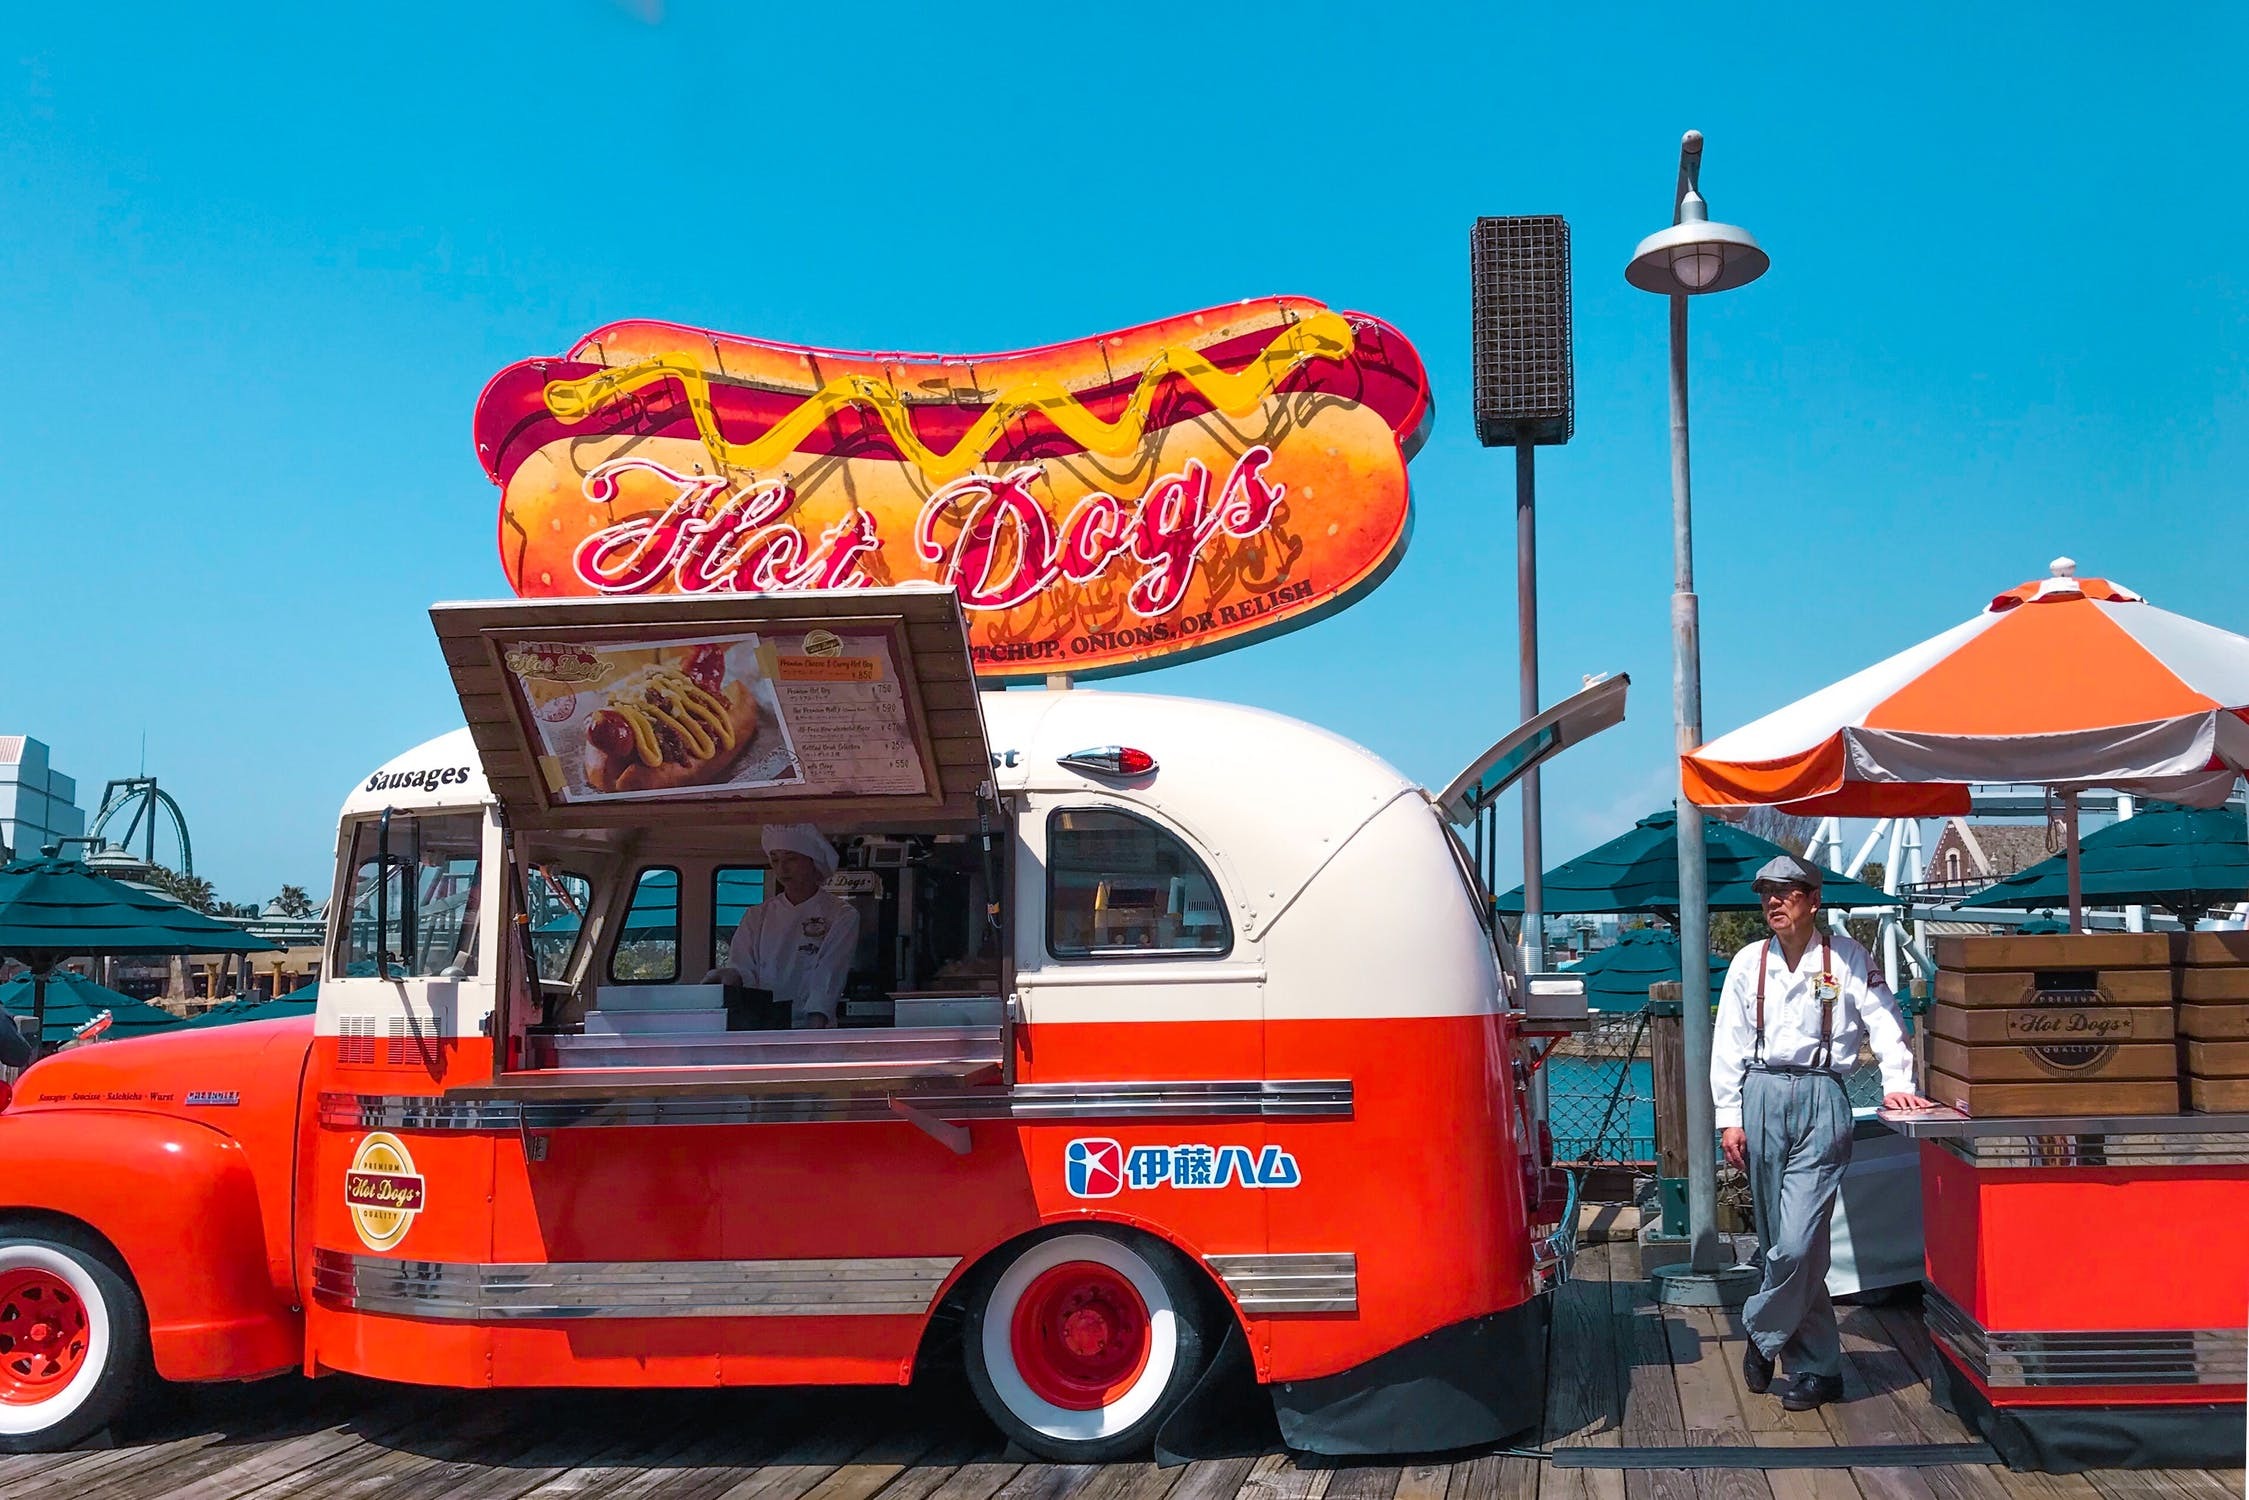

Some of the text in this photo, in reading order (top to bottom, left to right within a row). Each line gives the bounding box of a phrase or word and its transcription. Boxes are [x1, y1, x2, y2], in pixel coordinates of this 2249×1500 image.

[572, 445, 1286, 618] Hot Dogs
[967, 579, 1315, 663] TCHUP, ONIONS, OR RELISH
[365, 766, 470, 792] Sausages
[2039, 995, 2097, 1003] PREMIUM
[2020, 1012, 2119, 1037] Hot Dogs
[2043, 1045, 2098, 1054] QUALITY
[363, 1161, 400, 1171] PREMIUM
[1127, 1147, 1299, 1186] 伊藤ハム
[352, 1176, 415, 1208] Hot Dogs
[363, 1210, 398, 1220] QUALITY
